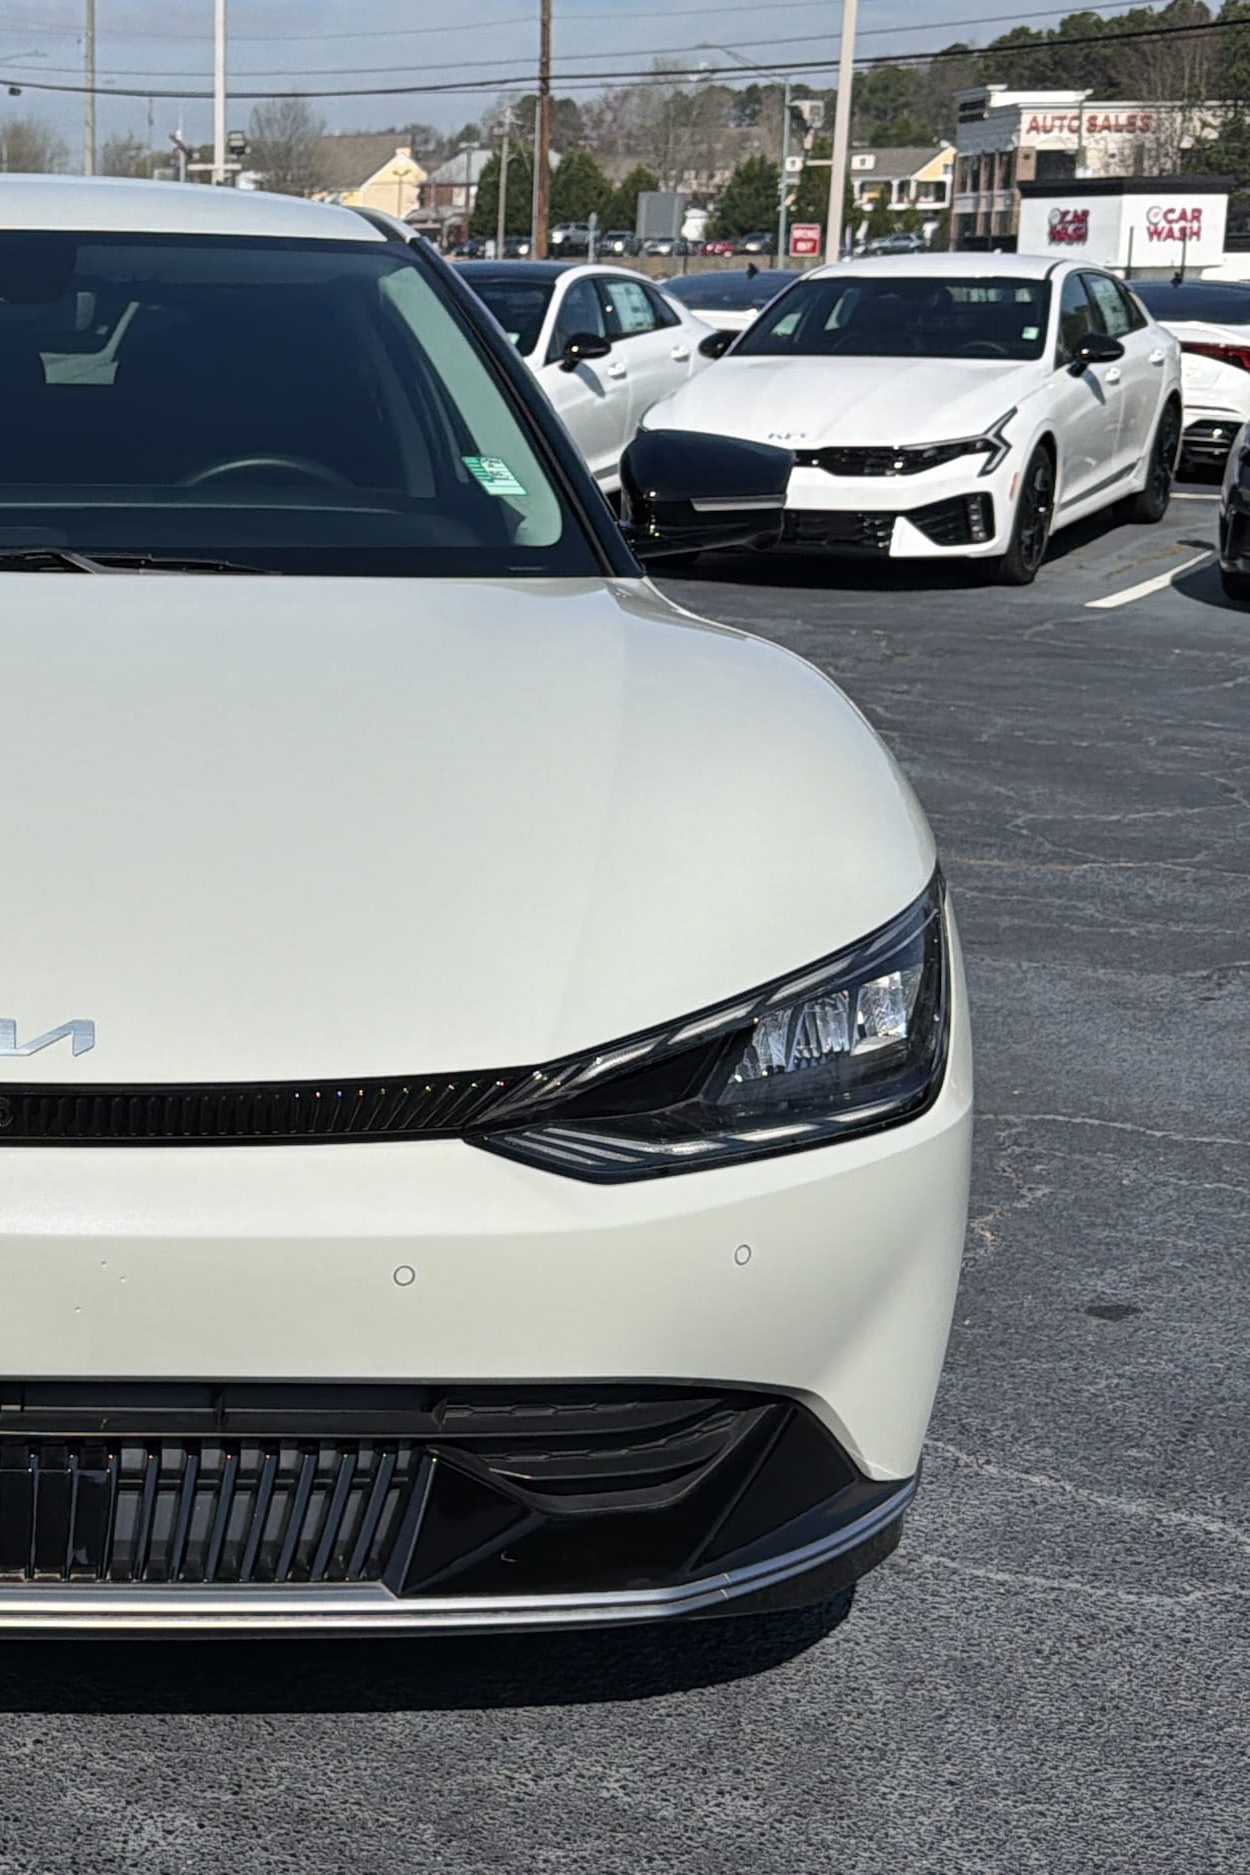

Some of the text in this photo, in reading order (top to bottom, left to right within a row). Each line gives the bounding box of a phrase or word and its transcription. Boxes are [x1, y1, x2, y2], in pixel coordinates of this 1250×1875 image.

[1026, 114, 1151, 134] AUTO SALES
[1163, 207, 1203, 224] CAR
[1146, 224, 1203, 242] WASH
